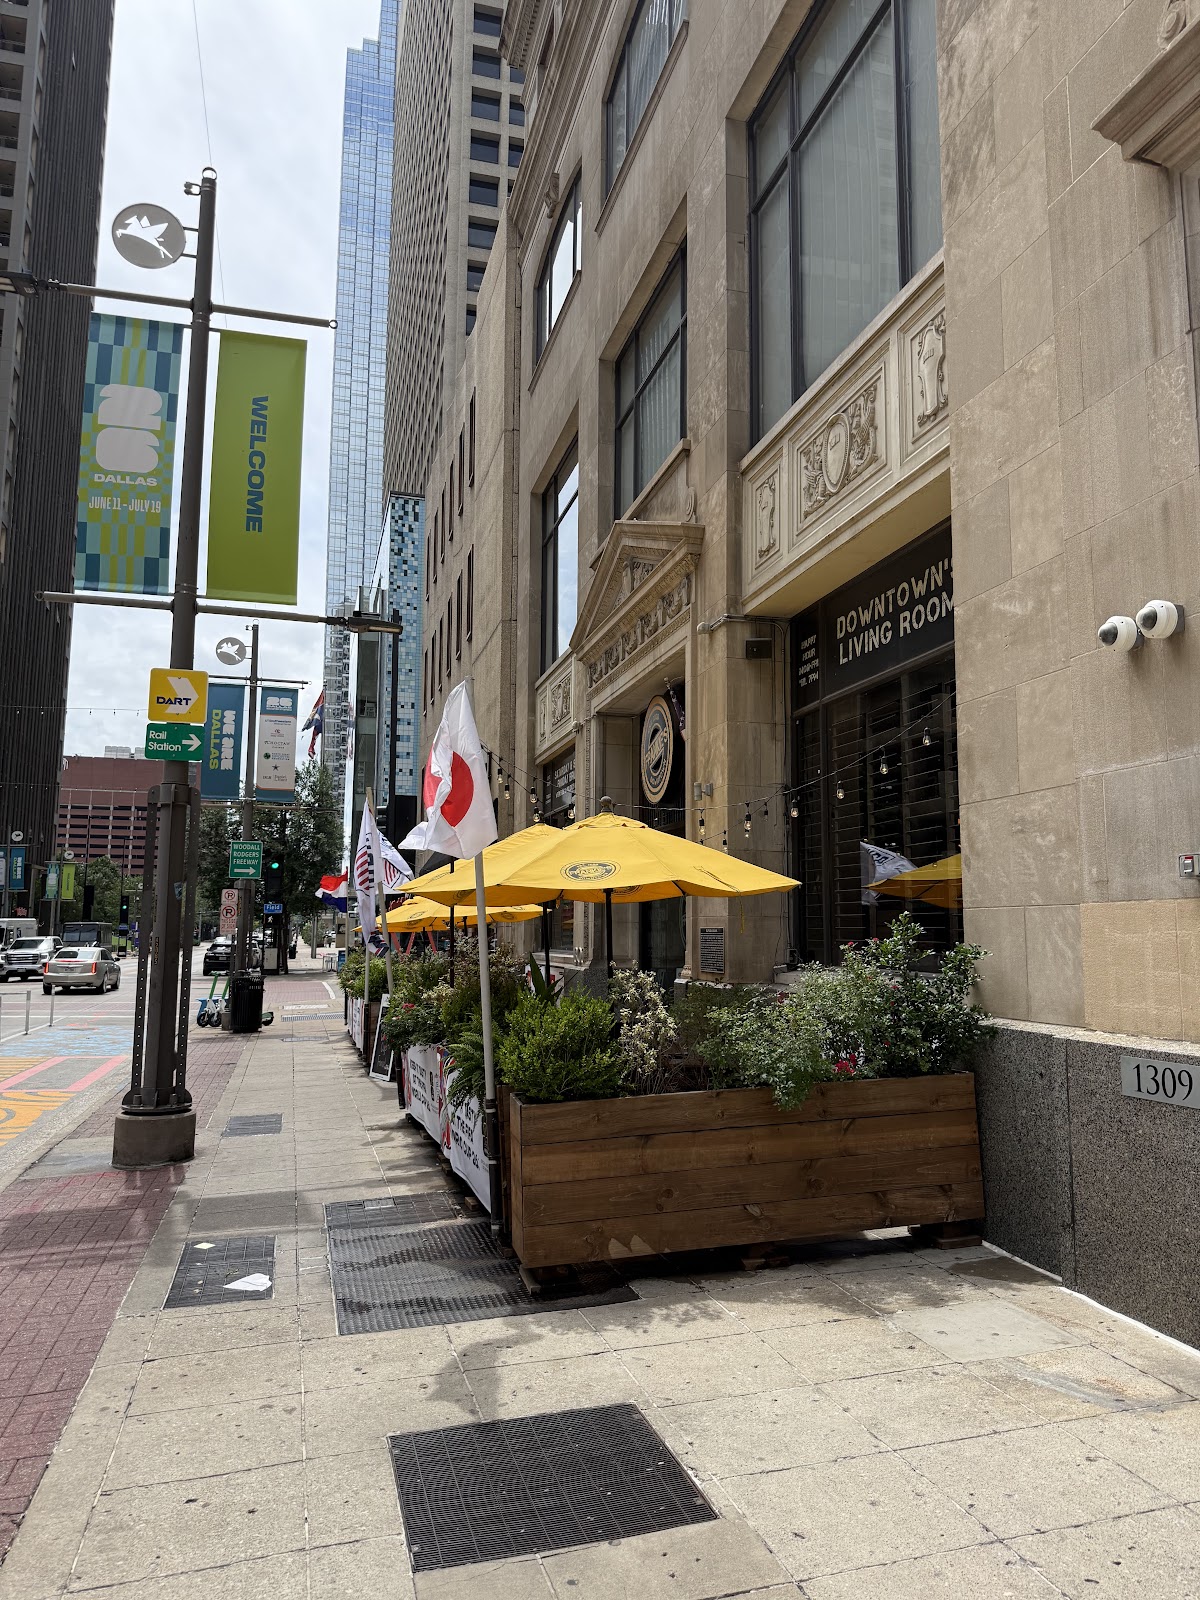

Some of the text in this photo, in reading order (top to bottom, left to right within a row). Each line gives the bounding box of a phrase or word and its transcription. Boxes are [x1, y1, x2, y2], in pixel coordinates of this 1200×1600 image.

[246, 395, 269, 533] WELCOME
[94, 473, 158, 487] DALLAS
[88, 495, 112, 510] JUNE
[112, 497, 122, 511] 11
[128, 498, 150, 513] JULY
[150, 500, 162, 514] 19
[839, 620, 893, 666] LIVING
[802, 647, 816, 662] HOUR
[157, 696, 191, 706] DART
[149, 730, 167, 740] Rail
[210, 709, 222, 769] DALLAS
[221, 710, 236, 770] WE ARE
[148, 741, 182, 751] Station
[1133, 1063, 1193, 1101] 1309
